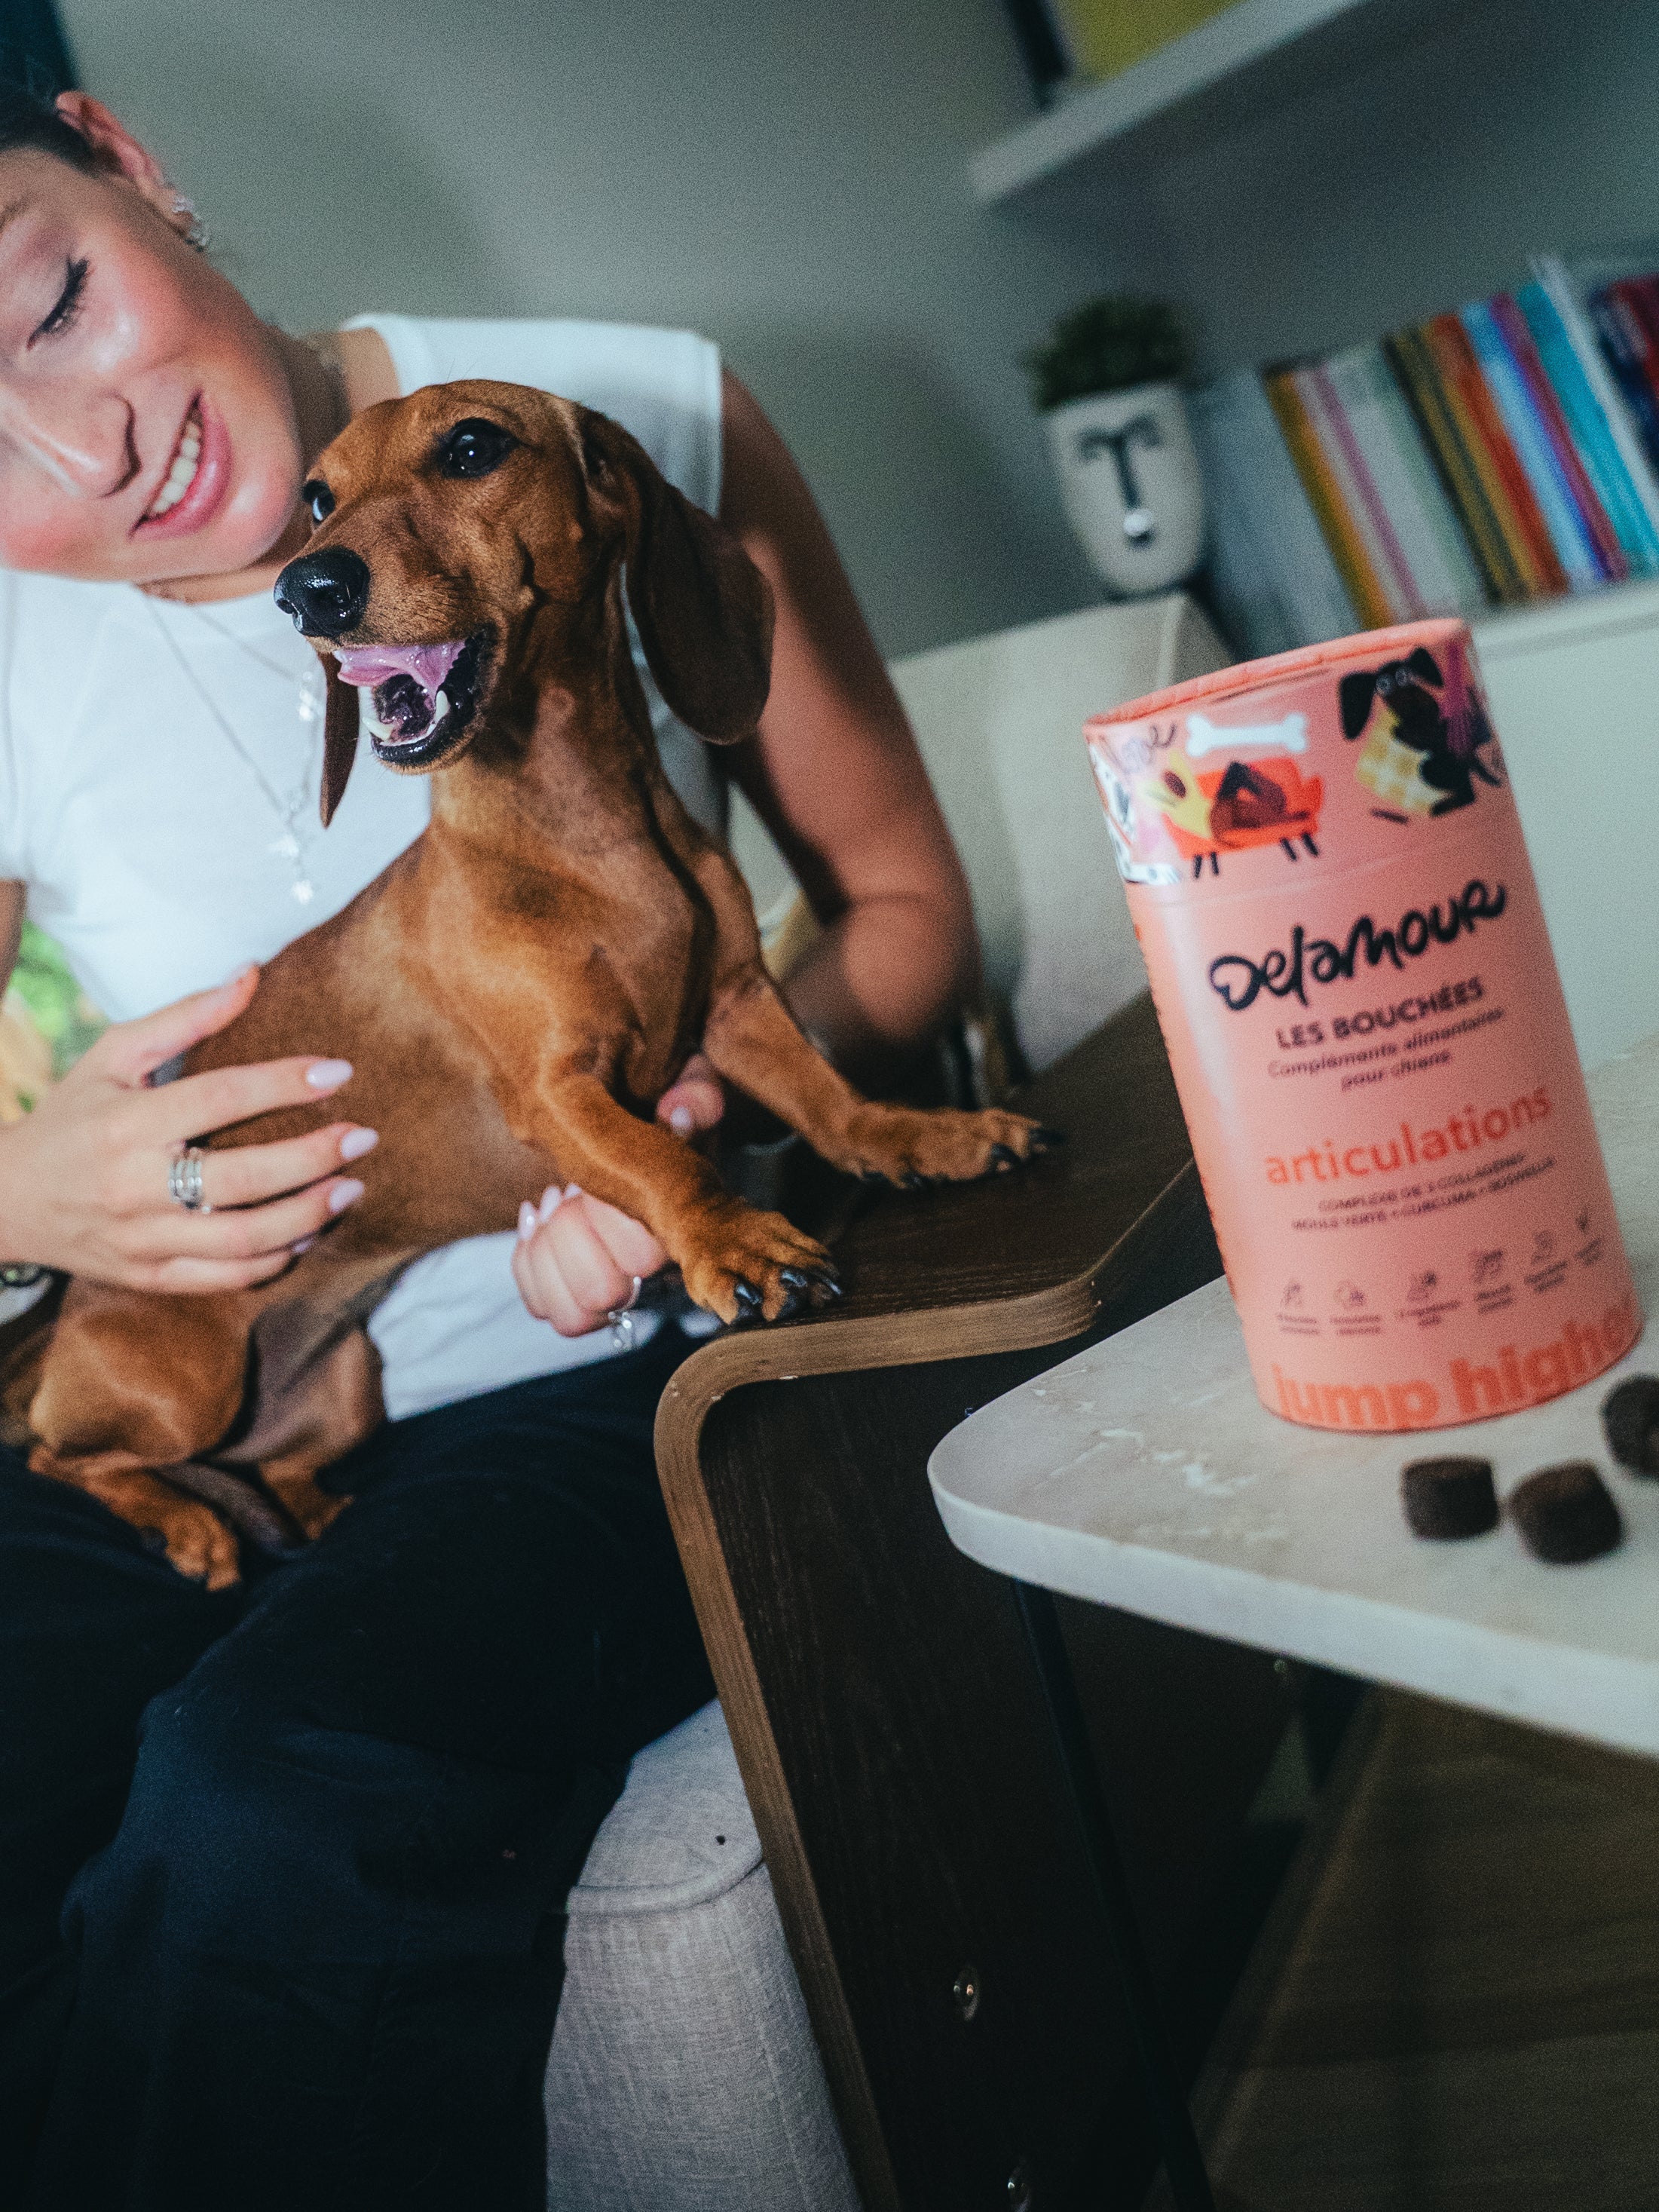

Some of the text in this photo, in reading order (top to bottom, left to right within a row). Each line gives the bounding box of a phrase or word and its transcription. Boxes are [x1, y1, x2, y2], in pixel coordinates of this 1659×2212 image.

[1275, 976, 1484, 1050] LES BOUCHÉES
[1340, 1068, 1385, 1092] pour
[1264, 1087, 1552, 1187] articulations
[1272, 1363, 1439, 1429] jump
